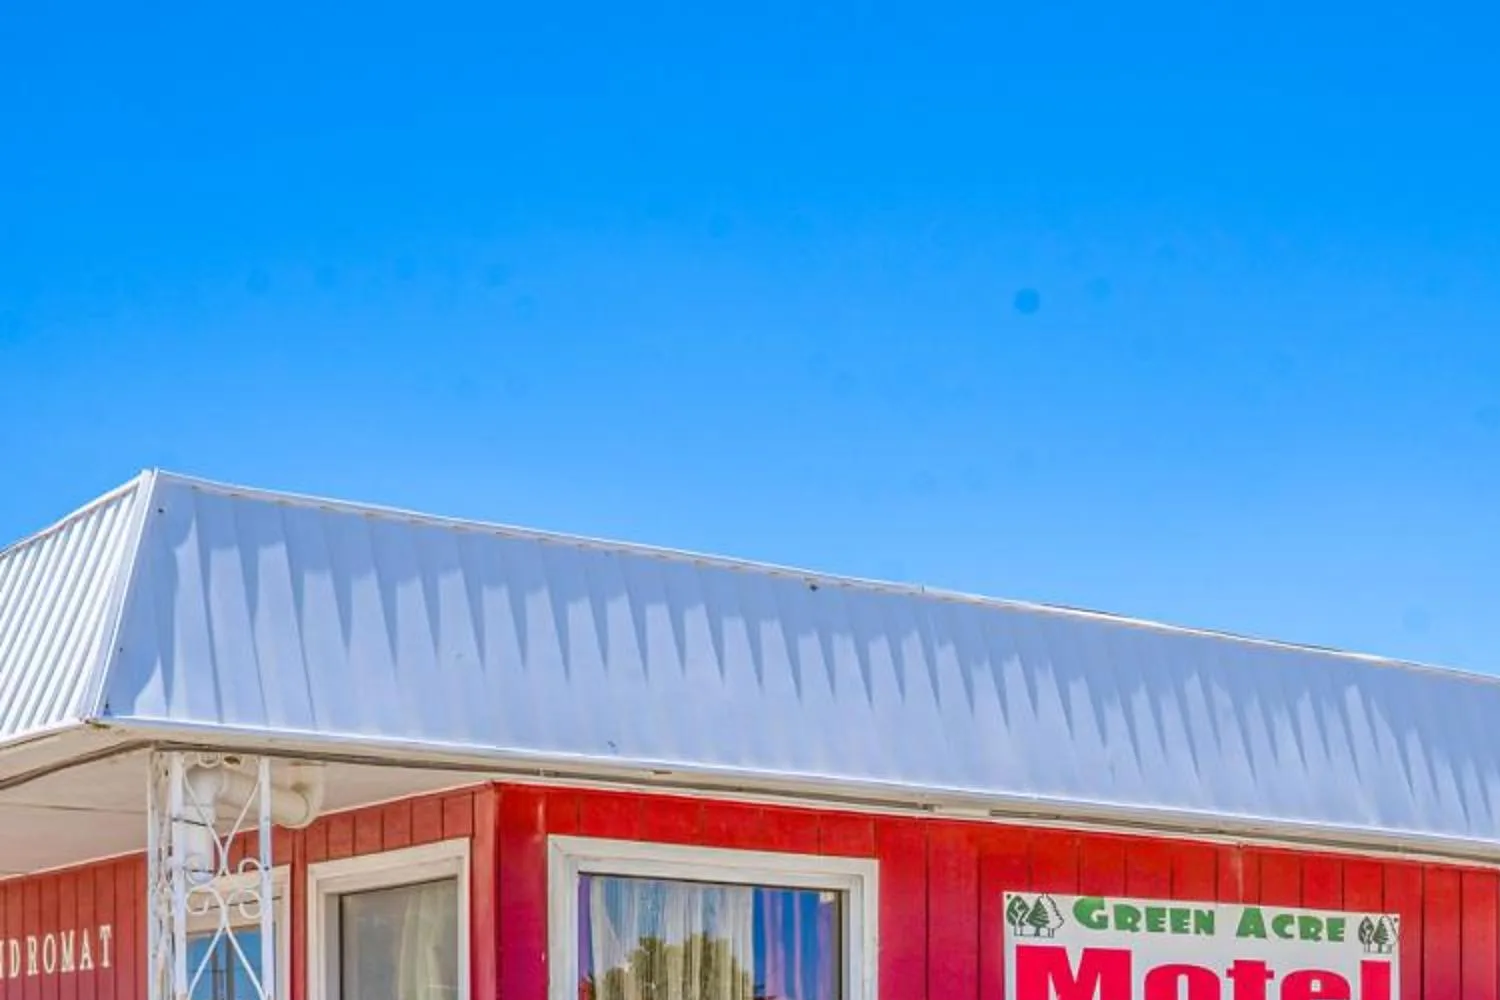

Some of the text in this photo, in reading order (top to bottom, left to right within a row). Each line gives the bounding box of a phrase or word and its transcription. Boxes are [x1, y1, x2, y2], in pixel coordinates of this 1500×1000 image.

[1072, 896, 1346, 942] GREEN ACRE
[0, 924, 112, 979] DROMAT
